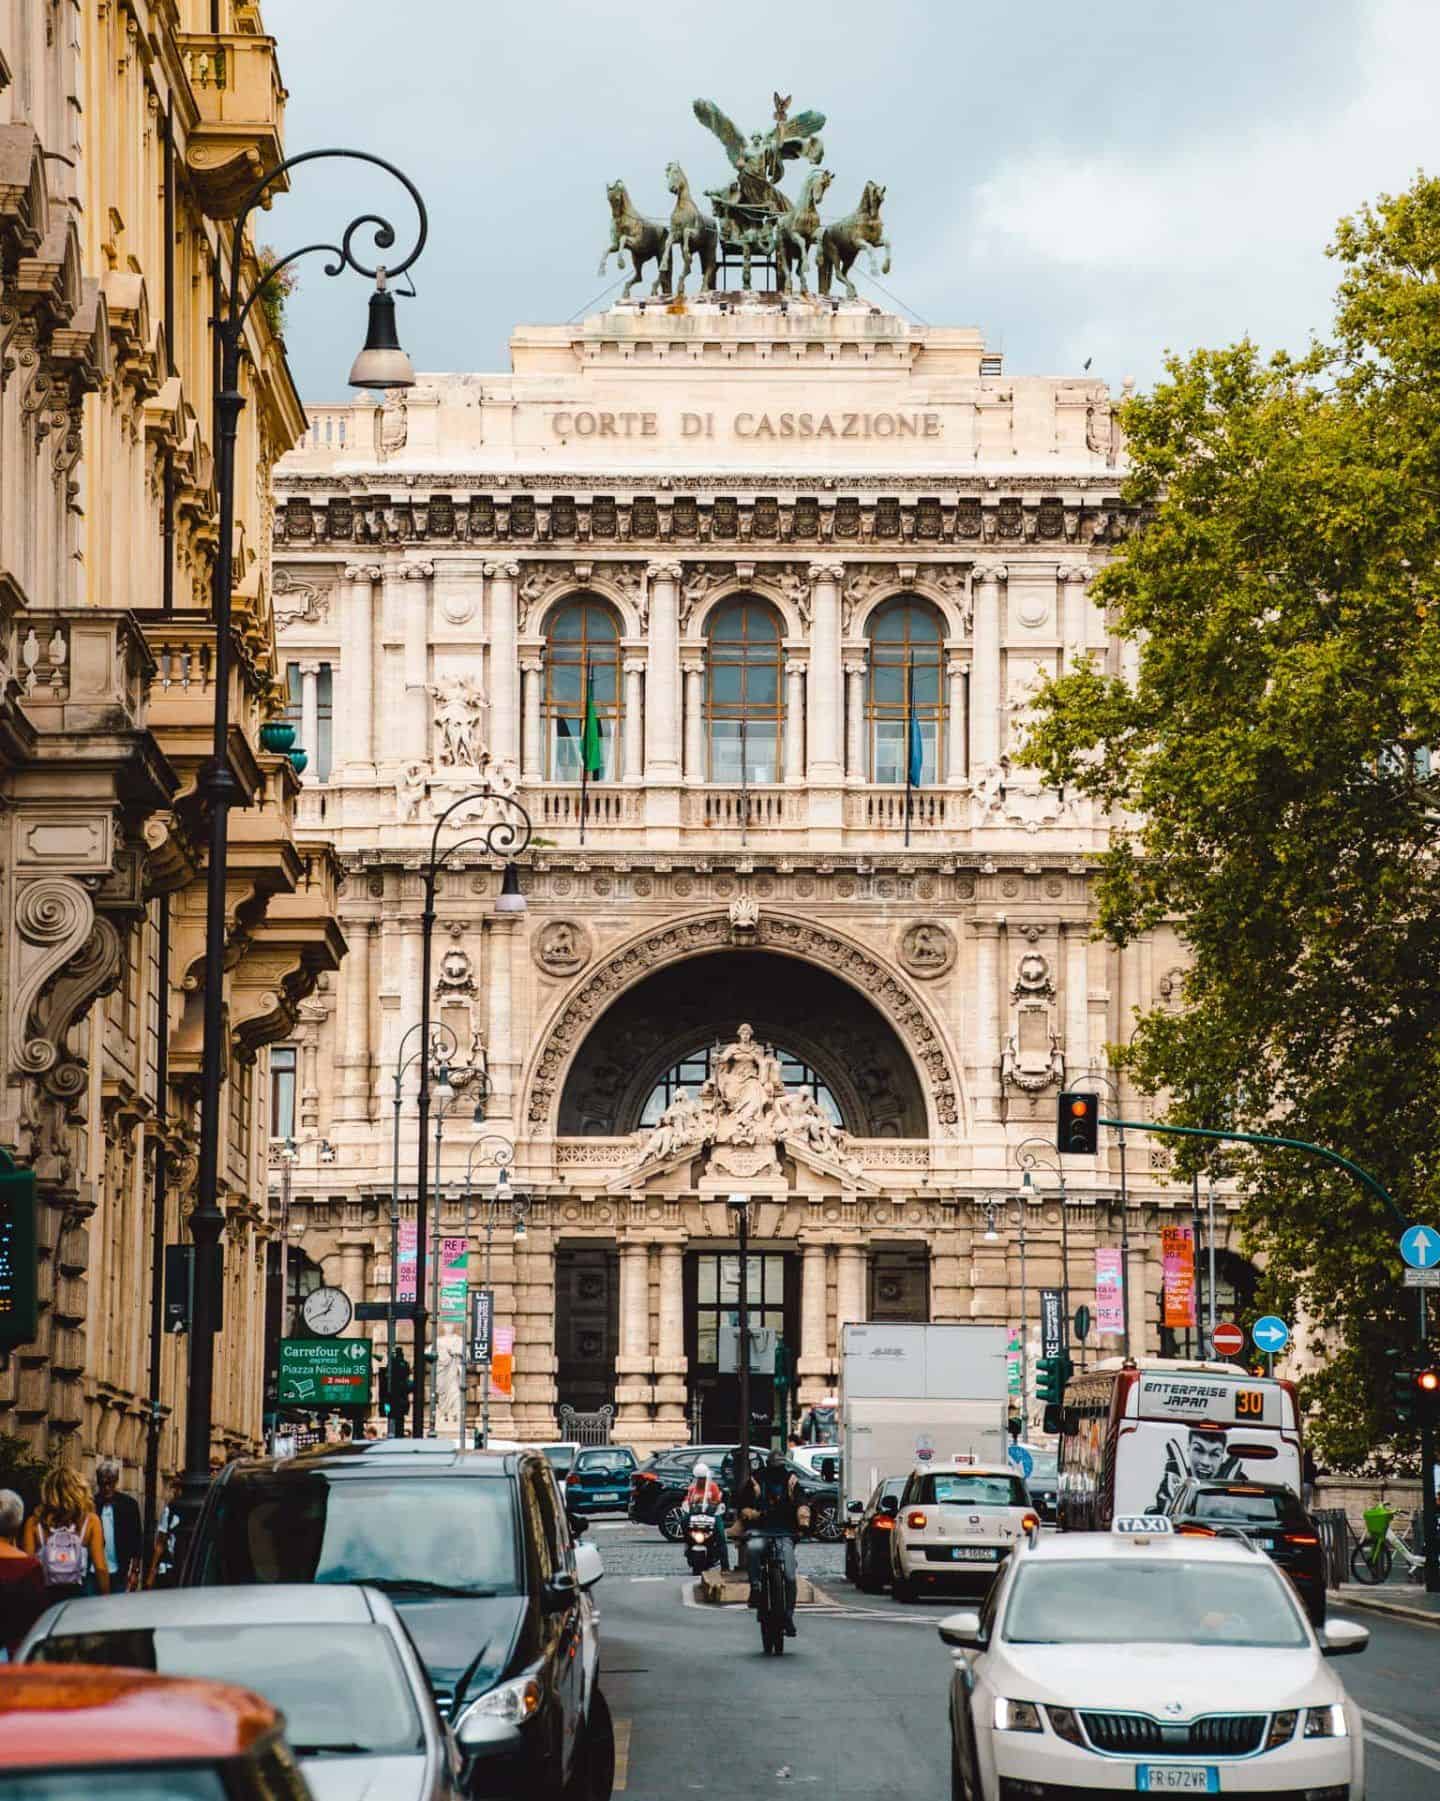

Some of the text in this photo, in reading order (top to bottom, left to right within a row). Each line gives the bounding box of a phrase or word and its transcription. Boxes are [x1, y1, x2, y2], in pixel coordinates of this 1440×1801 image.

[551, 411, 941, 438] CORTE DI CASSAZIONE
[444, 1240, 457, 1250] RE
[476, 1292, 489, 1300] F
[1044, 1292, 1057, 1300] F
[283, 1346, 340, 1357] Carrefour
[474, 1343, 488, 1360] RE
[1046, 1342, 1059, 1359] RE
[282, 1364, 366, 1375] Piazza Nicosia 35
[1144, 1382, 1228, 1398] ENTERPRISE
[1163, 1395, 1209, 1409] JAPAN
[1237, 1389, 1262, 1414] 30
[1119, 1518, 1166, 1532] TAXI
[1149, 1770, 1206, 1787] FR 672VR
